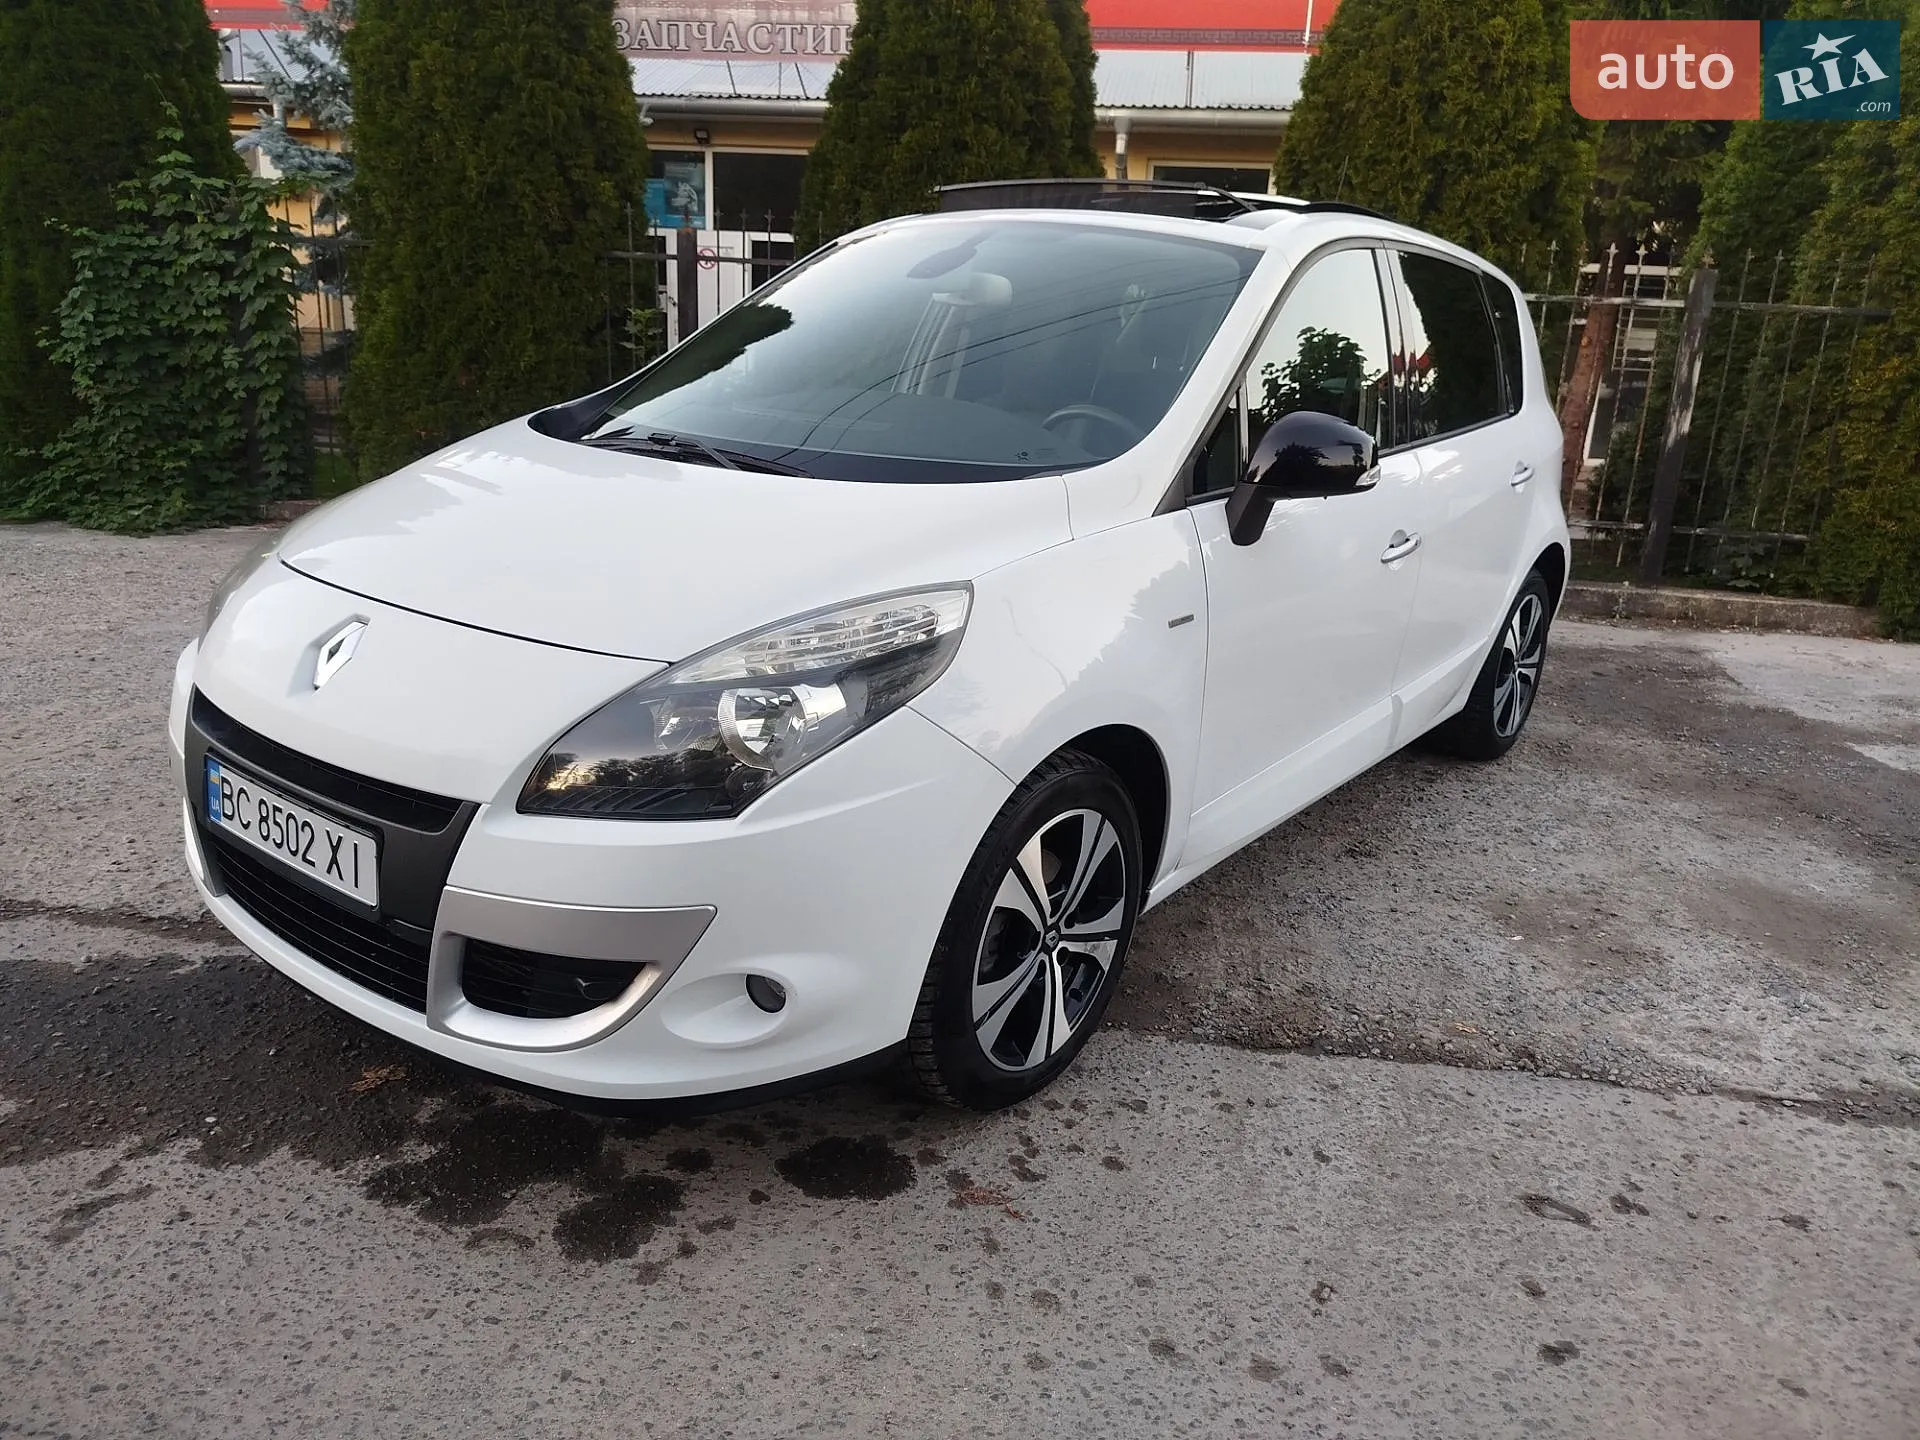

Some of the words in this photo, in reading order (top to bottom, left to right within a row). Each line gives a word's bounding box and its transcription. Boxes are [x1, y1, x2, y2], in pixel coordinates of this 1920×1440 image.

[221, 775, 251, 830] BC
[258, 798, 316, 868] 8502
[325, 828, 359, 889] XI
